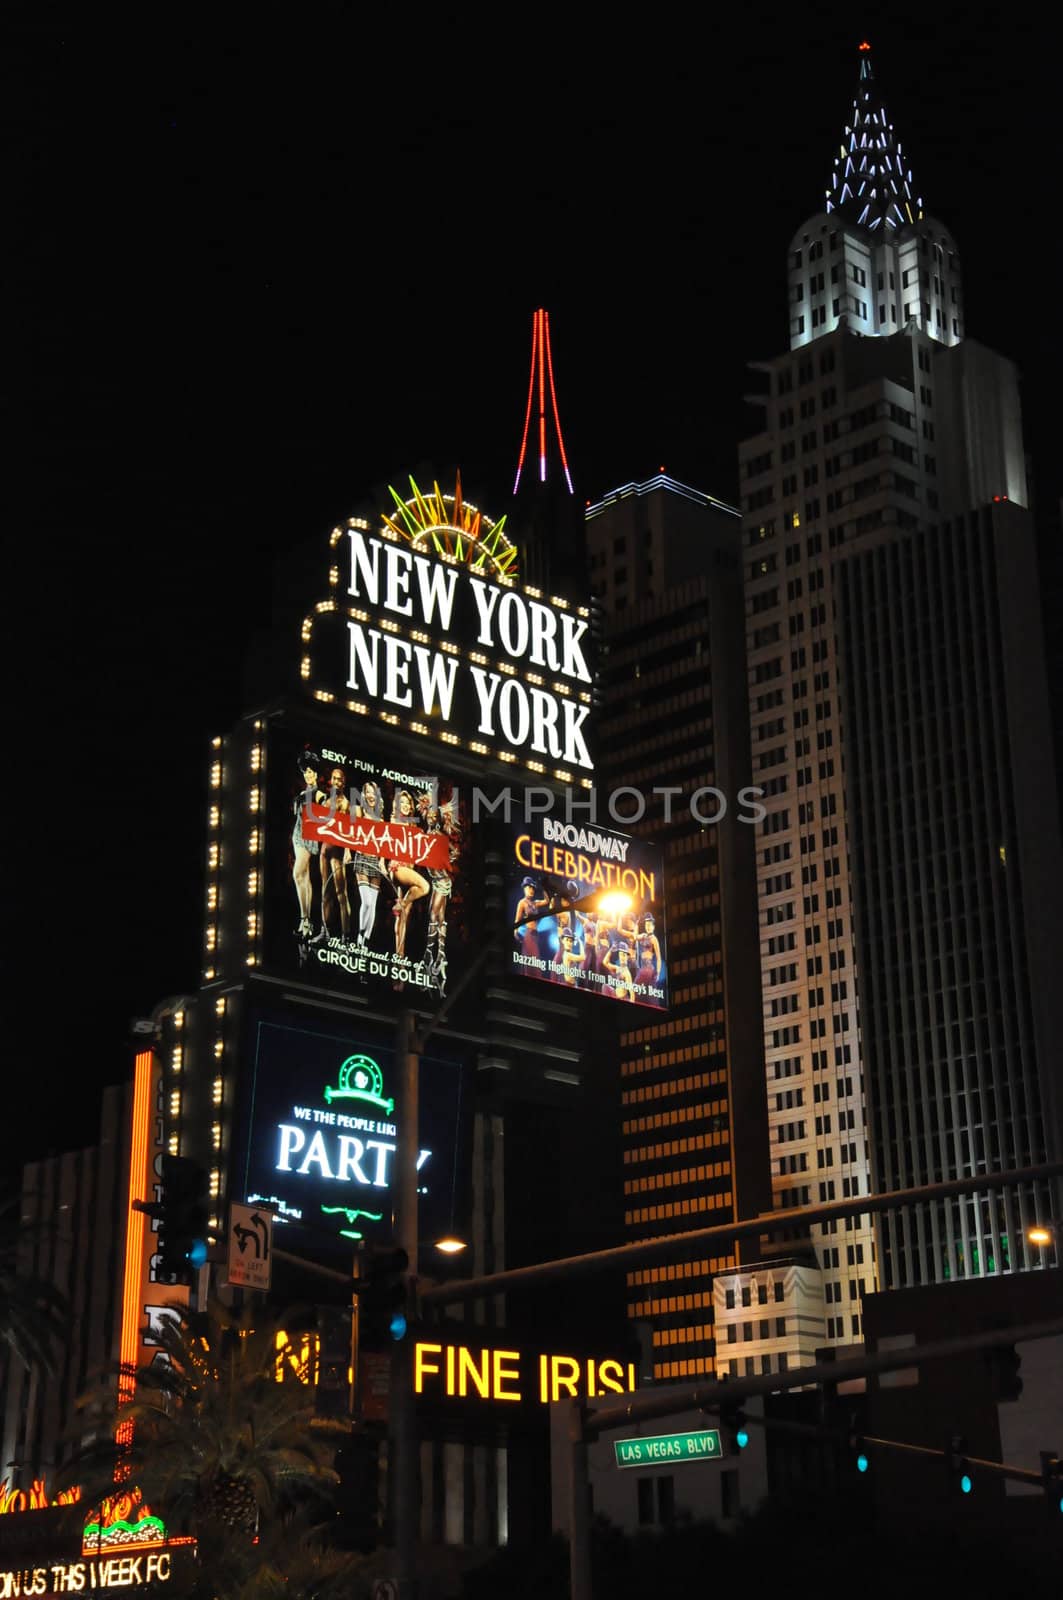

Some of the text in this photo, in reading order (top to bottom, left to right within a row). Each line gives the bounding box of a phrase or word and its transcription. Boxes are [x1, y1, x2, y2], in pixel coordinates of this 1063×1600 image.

[347, 529, 593, 684] NEW YORK
[346, 621, 594, 770] NEW YORK
[321, 748, 348, 765] SEXY
[354, 759, 375, 774] FUN
[543, 817, 629, 863] BROADWAY
[514, 834, 656, 902] CELEBRATION
[317, 949, 367, 974] CIRQUE
[369, 961, 388, 977] DU
[328, 938, 346, 951] The
[391, 952, 412, 967] Side
[413, 960, 425, 973] of
[512, 951, 664, 999] Dazzling Highlights from Broadway's Best
[293, 1105, 312, 1121] WE
[313, 1110, 335, 1125] THE
[337, 1114, 376, 1133] PEOPLE
[414, 1342, 521, 1401] FINE
[620, 1435, 715, 1461] LAS VEGAS BLVD
